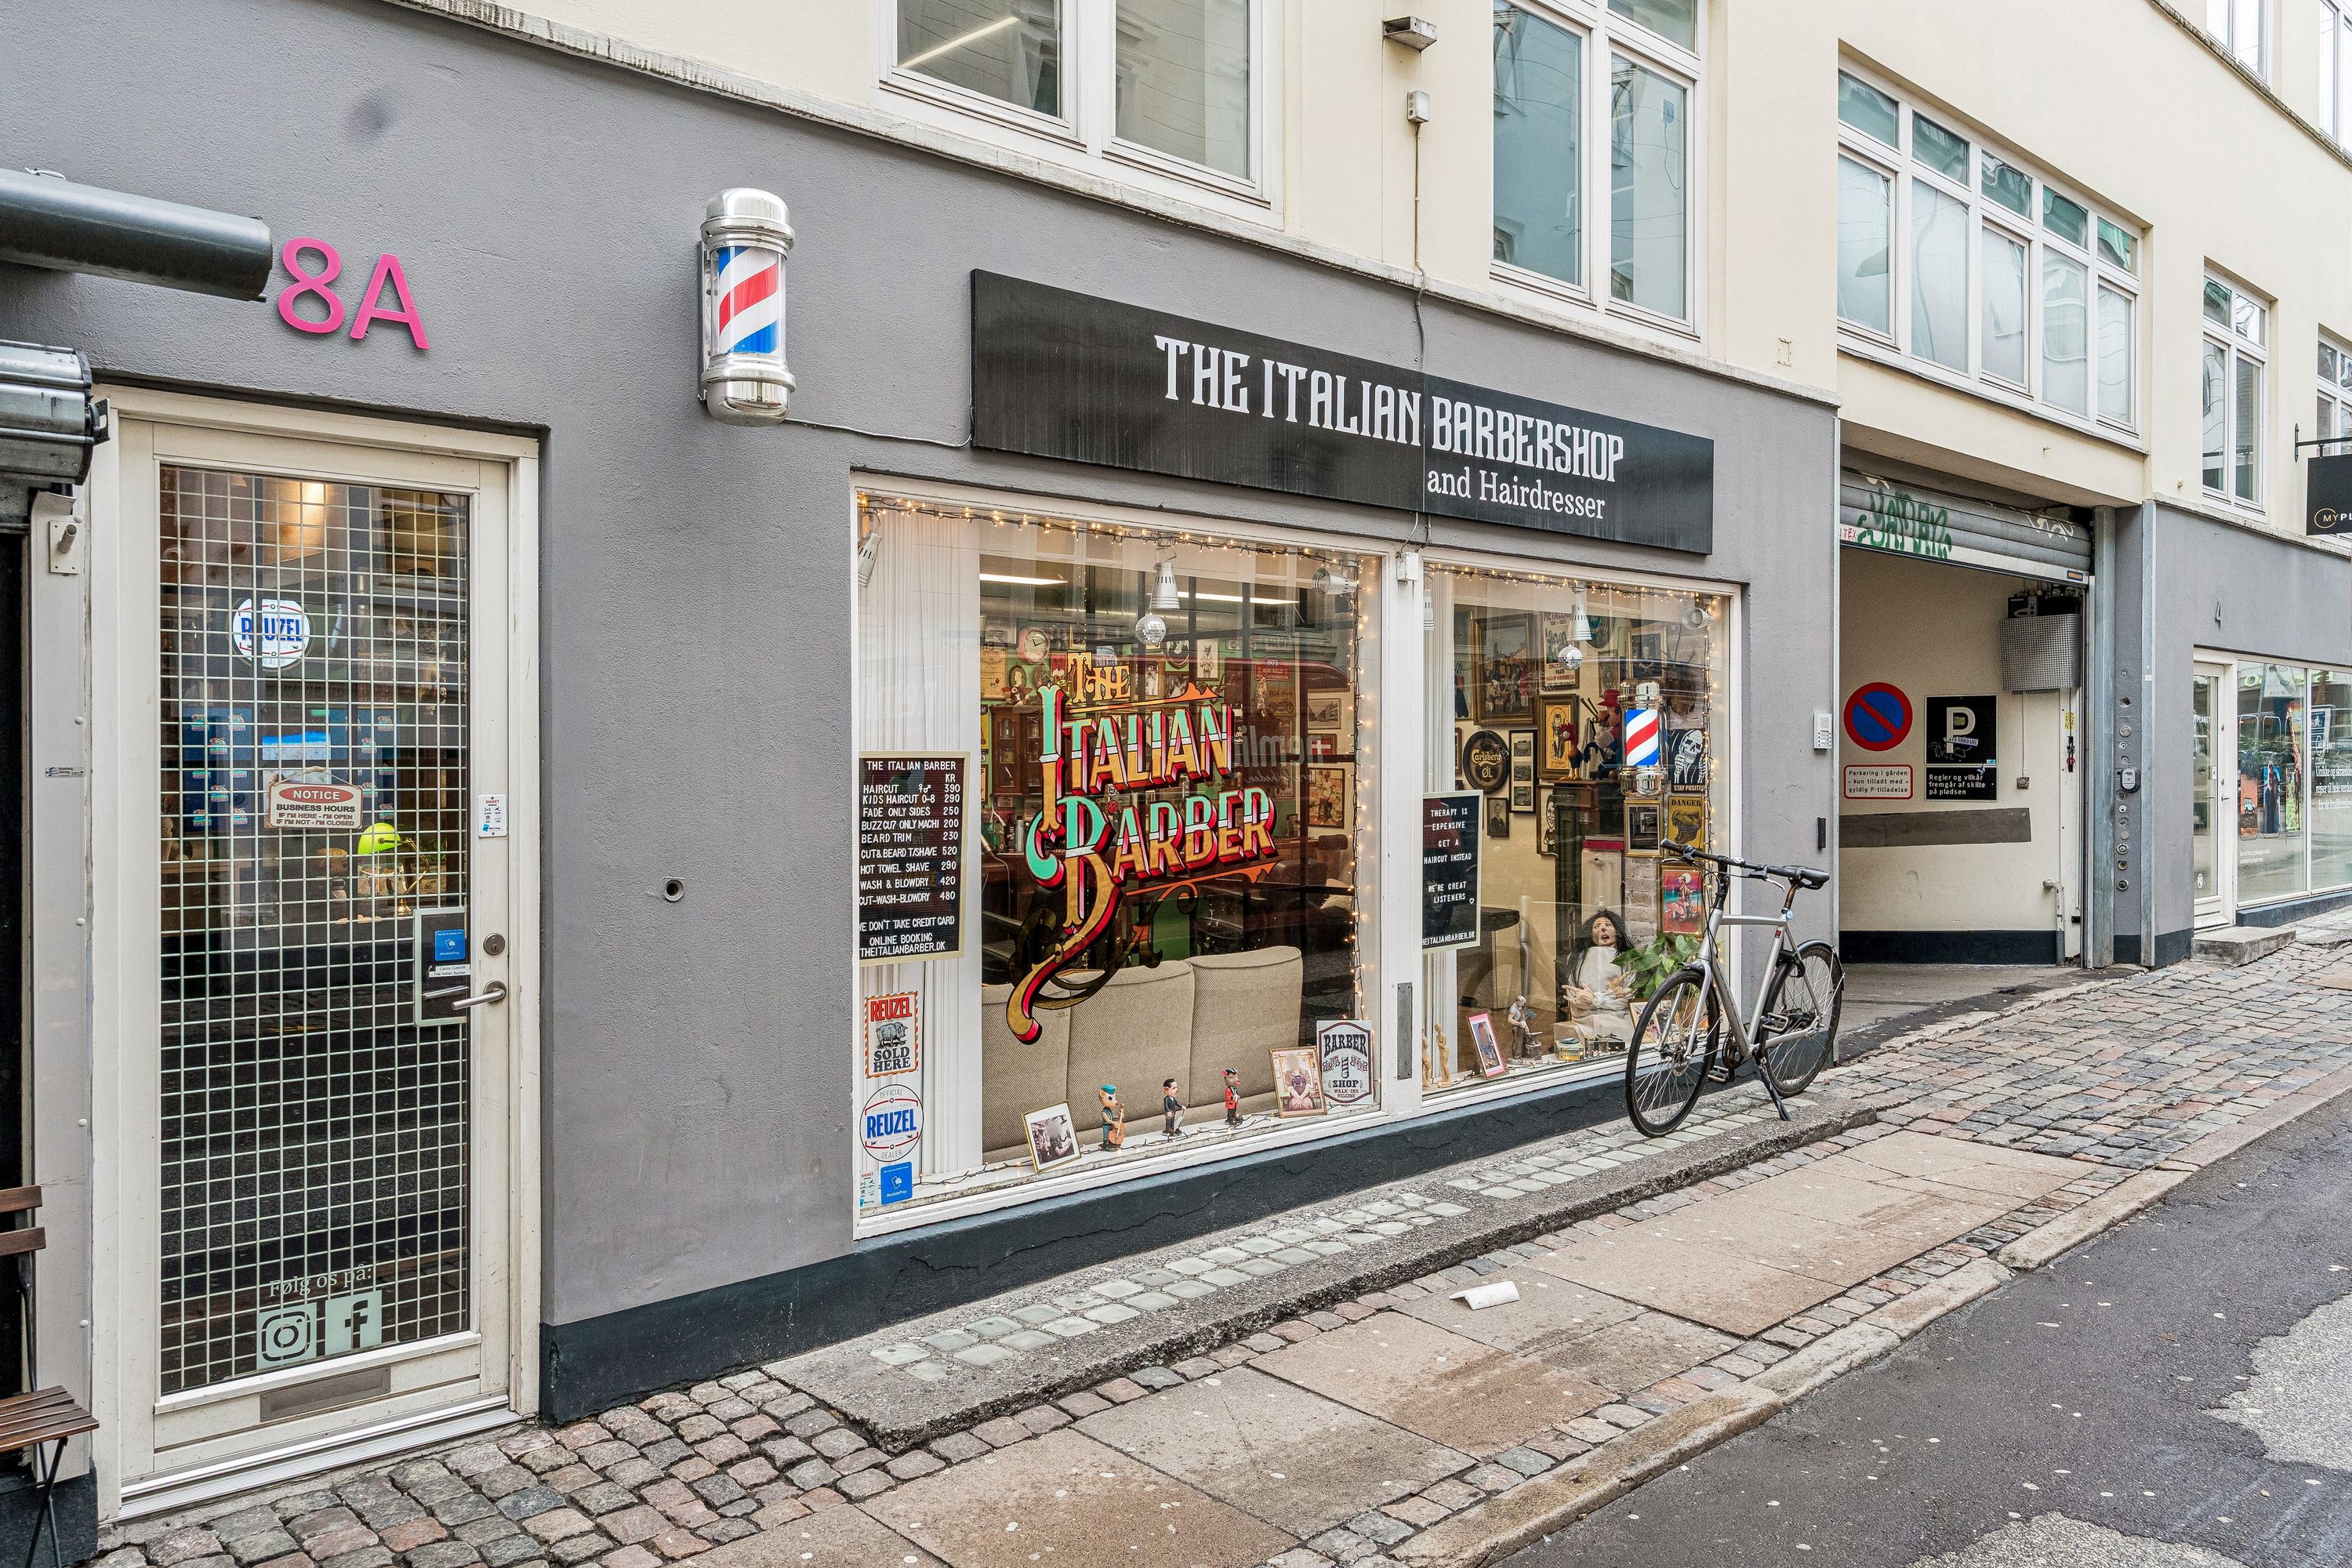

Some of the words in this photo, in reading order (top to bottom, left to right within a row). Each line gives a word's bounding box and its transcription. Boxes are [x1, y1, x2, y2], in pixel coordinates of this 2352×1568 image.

[278, 237, 430, 350] 8A
[1154, 334, 1250, 414] THE
[1262, 358, 1422, 448] ITALIAN
[1431, 395, 1624, 483] BARBERSHOP
[1428, 467, 1472, 500] and
[1479, 468, 1606, 521] Hairdresser
[241, 617, 303, 641] RUZEL
[1067, 652, 1131, 703] THE
[1947, 707, 1976, 753] P
[1037, 681, 1235, 833] ITALIAN
[1472, 750, 1501, 767] Carlsberg
[866, 761, 884, 770] THE
[887, 761, 920, 770] ITALIAN
[924, 761, 956, 770] BARBER
[1482, 767, 1493, 778] ØL
[945, 774, 956, 782] KR
[292, 789, 340, 800] NOTICE
[863, 785, 899, 794] HAIRCUT
[944, 784, 960, 793] 390
[862, 794, 884, 805] KIDS
[886, 794, 919, 804] HAIRCUT
[922, 794, 935, 803] 0-8
[944, 794, 960, 803] 290
[863, 808, 884, 817] FADE
[888, 808, 906, 816] ONLY
[909, 807, 931, 816] SIDES
[943, 807, 959, 815] 250
[1430, 808, 1457, 817] THERAPY
[899, 820, 917, 829] ONLY
[918, 819, 939, 829] MACHI
[943, 819, 959, 828] 200
[1432, 821, 1465, 831] EXPENSIVE
[862, 833, 891, 844] BEARD
[892, 833, 912, 842] TRIM
[942, 832, 958, 840] 230
[942, 846, 957, 855] 520
[1424, 855, 1448, 865] HAIRCUT
[1450, 852, 1472, 862] INSTEAD
[860, 865, 875, 875] HOT
[877, 864, 901, 873] TOWEL
[906, 862, 930, 872] SHAVE
[941, 860, 956, 870] 290
[860, 880, 882, 891] WASH
[886, 880, 892, 888] &
[895, 877, 928, 888] BLOWDRY
[940, 876, 956, 885] 420
[1428, 884, 1444, 892] WE'RE
[859, 892, 931, 906] CUT-WASH-BLOWDRY
[940, 891, 956, 900] 480
[1434, 893, 1465, 904] LISTENERS
[1011, 786, 1279, 1027] BARBER
[869, 919, 891, 931] DON'T
[892, 919, 911, 929] TAKE
[912, 916, 937, 927] CREDIT
[938, 916, 955, 926] CARD
[869, 935, 898, 946] ONLINE
[900, 933, 933, 944] BOOKING
[859, 941, 946, 957] THEITALIANBARBER.DK
[870, 996, 913, 1022] REUZEL
[1324, 1034, 1367, 1058] BARBER
[873, 1047, 909, 1061] SOLD
[873, 1057, 911, 1073] HERE
[880, 1088, 902, 1098] OFFICIAL
[867, 1109, 916, 1138] REUZEL
[881, 1149, 902, 1160] DEALER
[269, 1276, 310, 1297] Følg
[317, 1273, 337, 1287] os
